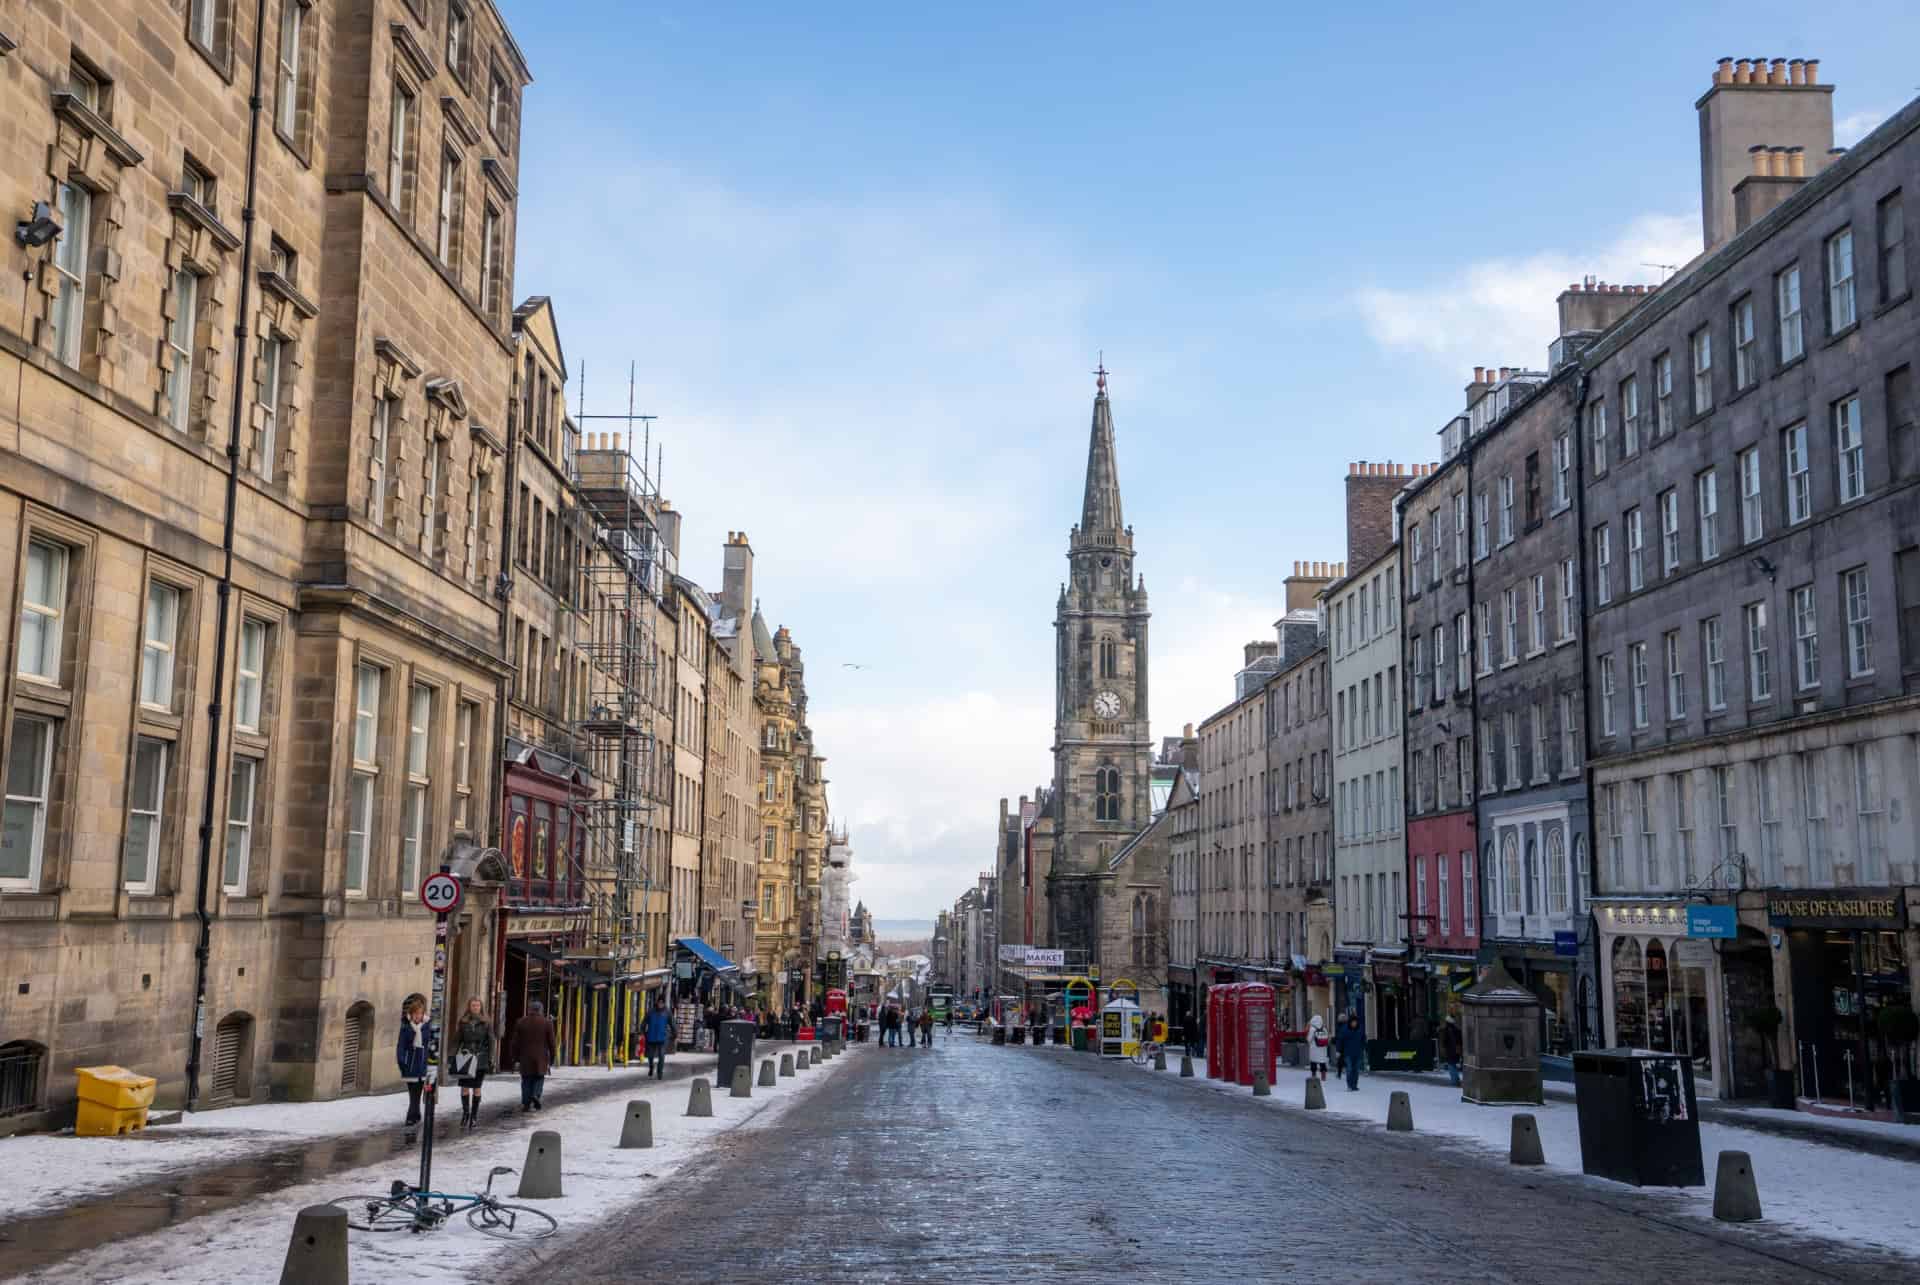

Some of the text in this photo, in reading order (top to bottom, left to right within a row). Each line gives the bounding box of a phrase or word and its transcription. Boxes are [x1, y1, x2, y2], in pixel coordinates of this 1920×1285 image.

[427, 884, 454, 901] 20
[1771, 899, 1896, 917] HOUSE OF CASHMERE
[1026, 953, 1062, 962] MARKET
